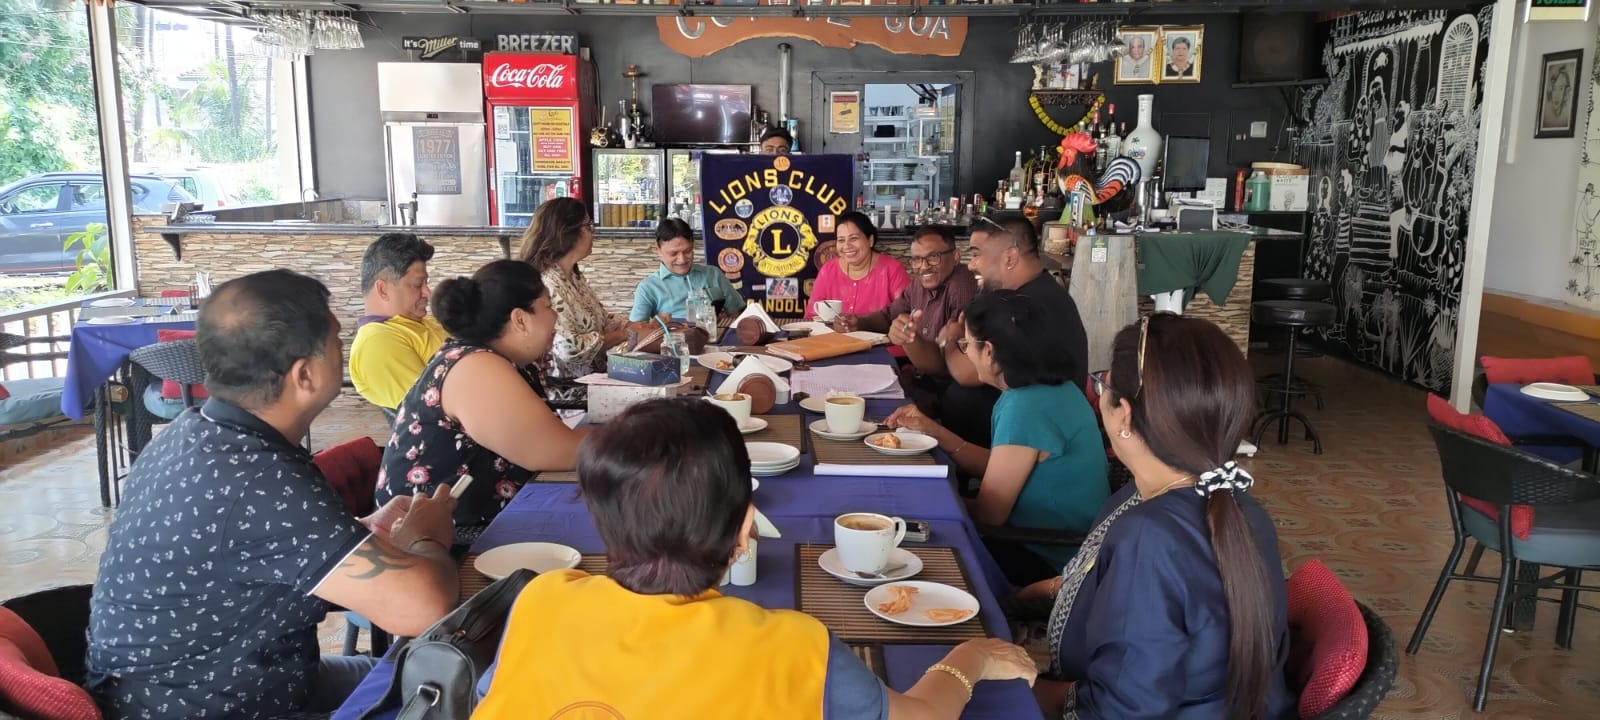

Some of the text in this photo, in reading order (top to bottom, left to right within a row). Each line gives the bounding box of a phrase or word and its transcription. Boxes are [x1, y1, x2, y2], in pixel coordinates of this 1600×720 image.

[884, 16, 950, 39] GOA
[404, 37, 479, 56] It's Miller time
[497, 34, 573, 53] BREEZER
[491, 63, 568, 89] Coca-Cola
[421, 139, 451, 154] 1977
[708, 168, 847, 215] LIONS CLUB
[757, 209, 800, 226] LIONS
[770, 229, 792, 255] L
